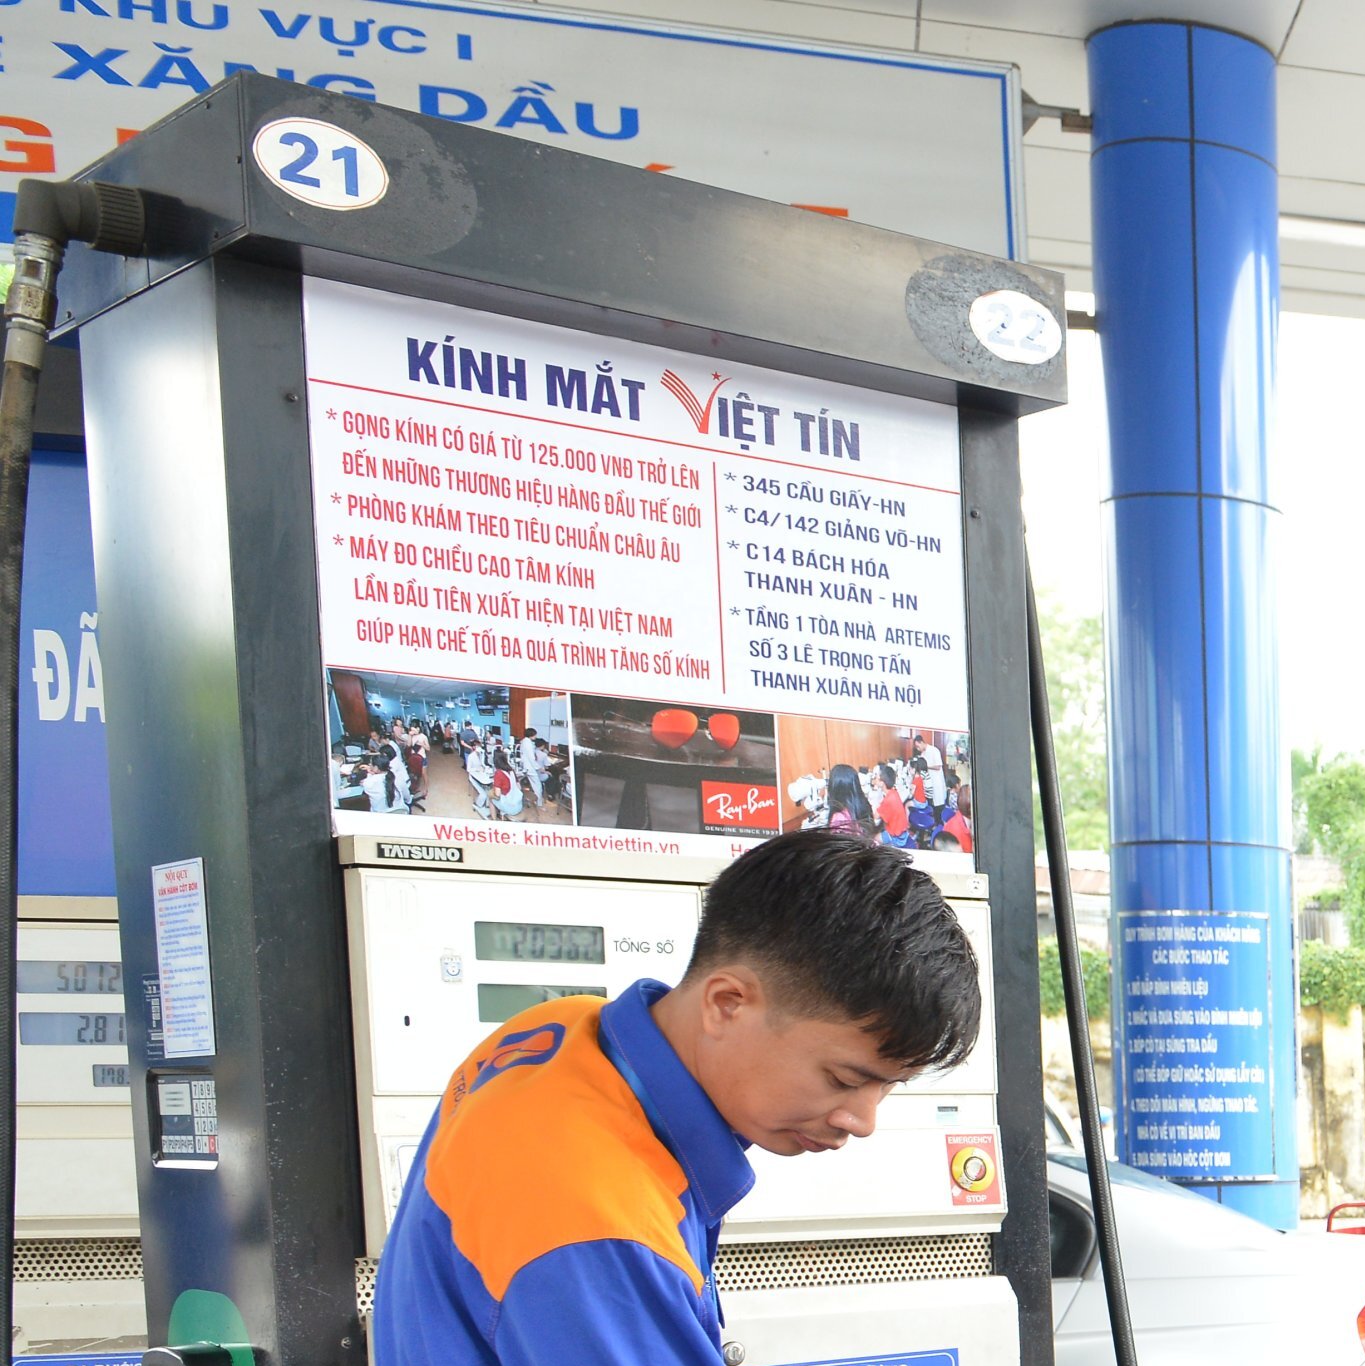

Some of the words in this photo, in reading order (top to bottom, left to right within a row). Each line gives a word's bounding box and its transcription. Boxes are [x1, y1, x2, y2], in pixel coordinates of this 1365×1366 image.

[258, 8, 427, 57] VỰC
[457, 33, 472, 61] I
[419, 80, 639, 140] DẦU
[279, 132, 359, 197] 21
[407, 335, 527, 401] KÍNH
[546, 360, 646, 422] MẮT
[660, 369, 780, 450] VIỆT
[794, 408, 860, 461] TÍN
[343, 411, 390, 439] GỌNG
[396, 417, 437, 447] KÍNH
[443, 426, 464, 451] CÓ
[469, 431, 497, 457] GIÁ
[501, 434, 521, 460] TỪ
[530, 443, 595, 473] 125.000
[601, 454, 632, 478] VNĐ
[638, 458, 666, 484] TRỞ
[672, 464, 699, 490] LÊN
[342, 449, 377, 479] ĐẾN
[382, 458, 440, 488] NHỮNG
[445, 468, 510, 499] THƯƠNG
[516, 478, 552, 508] HIỆU
[558, 484, 600, 512] HÀNG
[605, 489, 635, 518] ĐẦU
[640, 497, 670, 523] THẾ
[672, 504, 701, 528] GIỚI
[744, 475, 780, 496] 345
[787, 480, 823, 503] CẦU
[830, 489, 905, 517] GIẤY-HN
[348, 493, 406, 524] PHÒNG
[412, 503, 462, 532] KHÁM
[466, 512, 509, 539] THEO
[514, 517, 550, 544] TIÊU
[556, 522, 609, 553] CHUẨN
[614, 533, 655, 559] CHÂU
[661, 537, 680, 563] ÂU
[744, 507, 819, 534] C4/142
[825, 519, 880, 544] GIẢNG
[886, 529, 941, 553] VÕ-HN
[350, 534, 388, 562] MÁY
[394, 542, 417, 566] ĐO
[423, 544, 473, 574] CHIỀU
[478, 554, 510, 578] CAO
[515, 556, 551, 584] TÂM
[556, 562, 595, 590] KÍNH
[792, 549, 844, 573] BÁCH
[851, 558, 890, 580] HÓA
[354, 573, 388, 603] LẦN
[394, 578, 428, 608] ĐẦU
[433, 586, 472, 613] TIÊN
[477, 590, 520, 619] XUẤT
[526, 598, 564, 627] HIỆN
[568, 605, 594, 631] TẠI
[599, 607, 632, 635] VIỆT
[638, 614, 672, 638] NAM
[744, 571, 813, 596] THANH
[820, 582, 872, 605] XUÂN
[892, 593, 918, 611] HN
[356, 617, 394, 644] GIÚP
[399, 624, 431, 651] HẠN
[437, 626, 469, 653] CHẾ
[472, 629, 496, 656] TỐI
[501, 637, 522, 659] ĐA
[527, 638, 557, 663] QUÁ
[561, 641, 606, 669] TRÌNH
[610, 646, 648, 673] TĂNG
[653, 650, 672, 676] SỐ
[676, 653, 710, 680] KÍNH
[746, 605, 789, 630] TẦNG
[796, 616, 802, 631] 1
[809, 616, 839, 637] TÒA
[845, 620, 876, 641] NHÀ
[885, 627, 951, 650] ARTEMIS
[750, 637, 775, 658] SỐ
[778, 644, 788, 660] 3
[794, 645, 814, 664] LÊ
[819, 649, 873, 671] TRỌNG
[879, 653, 911, 675] TẤN
[751, 669, 810, 693] THANH
[816, 677, 862, 698] XUÂN
[868, 681, 890, 701] HÀ
[895, 685, 921, 707] NỘI
[381, 843, 460, 861] TATSUNO
[434, 823, 516, 844] Website:
[525, 830, 679, 854] kinhmatviettin.vn
[614, 936, 650, 953] TỔNG
[657, 939, 675, 954] SỐ
[948, 1136, 992, 1144] EMERGENCY
